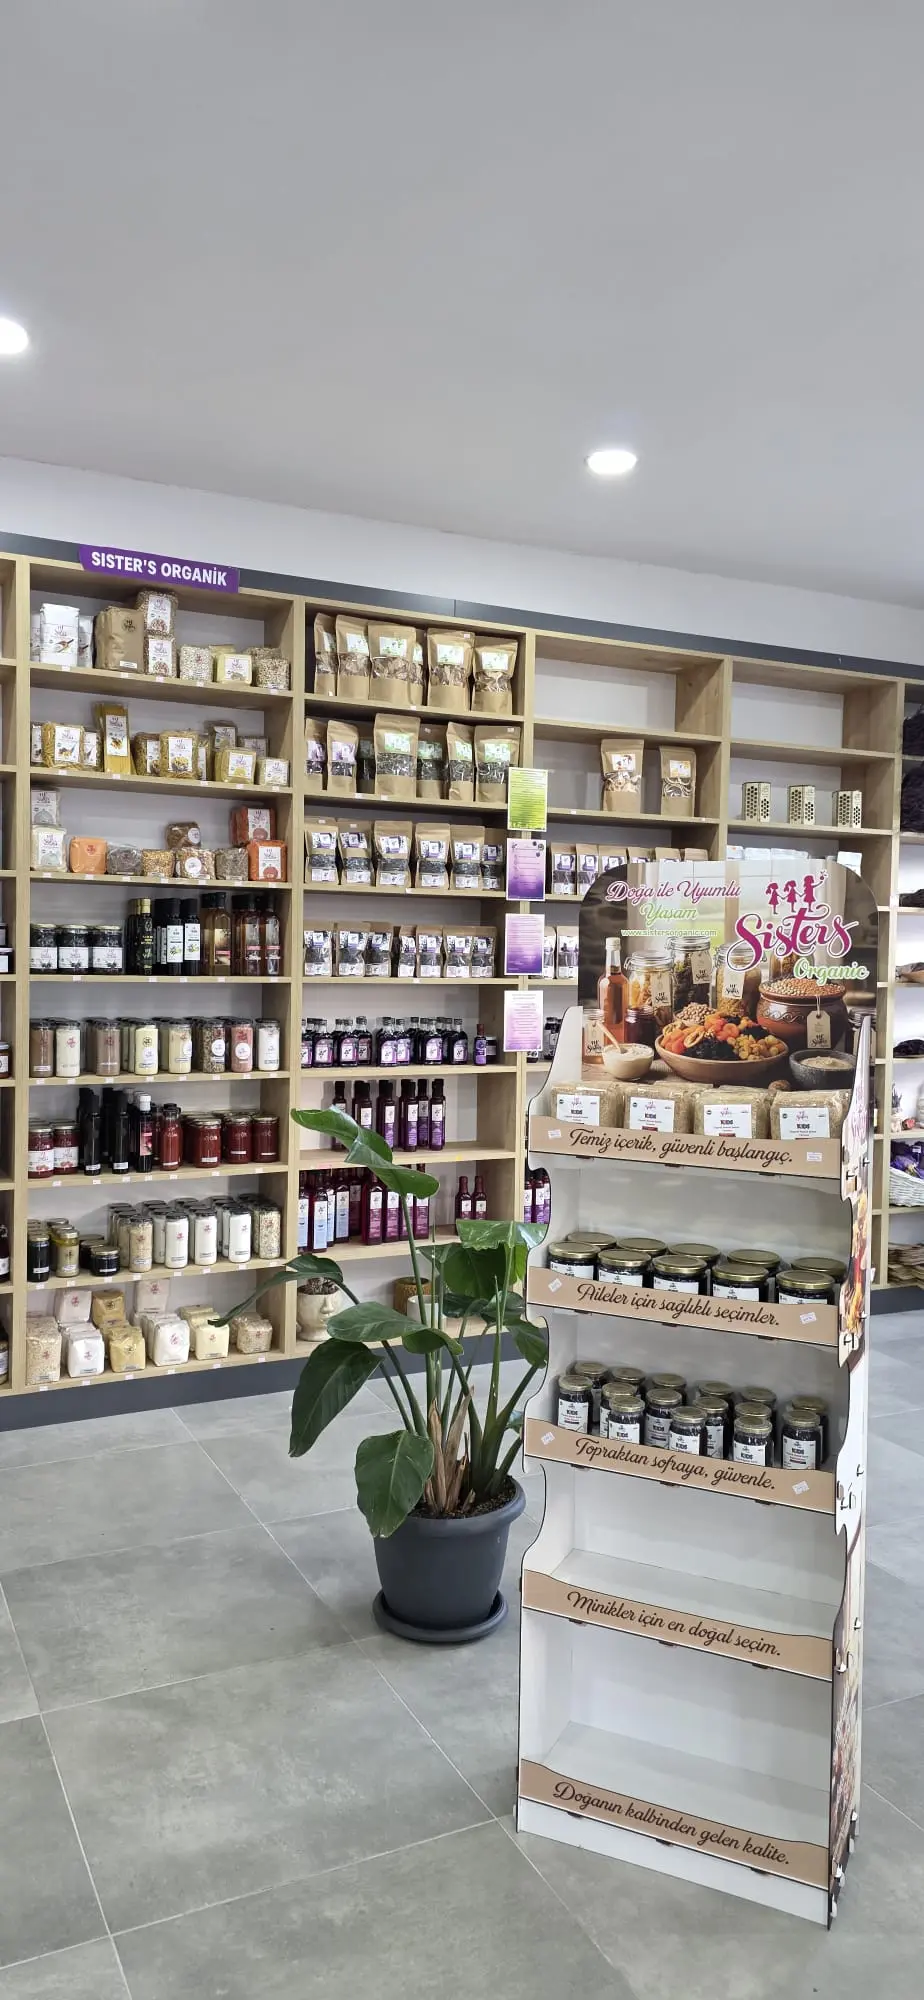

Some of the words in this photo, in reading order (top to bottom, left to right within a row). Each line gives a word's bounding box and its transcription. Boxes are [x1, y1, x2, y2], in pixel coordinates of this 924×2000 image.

[91, 552, 157, 575] SISTER'S
[161, 563, 227, 586] ORGANİK
[606, 880, 652, 905] Doğa
[657, 881, 675, 897] ile
[677, 880, 741, 904] Uyumlu
[727, 904, 859, 971] Sisters
[794, 958, 869, 985] Organic
[570, 1128, 612, 1153] Temiz
[614, 1134, 656, 1152] içerik,
[659, 1139, 715, 1158] güvenli
[717, 1141, 792, 1167] başlangıç.
[577, 1284, 628, 1304] Aileler
[631, 1293, 657, 1309] için
[659, 1297, 712, 1319] sağlıklı
[714, 1307, 779, 1325] seçimler.
[576, 1438, 648, 1465] Topraktan
[650, 1455, 708, 1480] sofraya,
[711, 1467, 775, 1489] güvenle.
[567, 1591, 636, 1620] Minikler
[638, 1610, 665, 1627] için
[668, 1620, 685, 1633] en
[688, 1621, 734, 1646] doğal
[733, 1635, 780, 1655] seçim.
[553, 1781, 622, 1810] Doğanın
[625, 1802, 697, 1836] kalbinden
[697, 1829, 740, 1849] gelen
[742, 1837, 789, 1864] kalite.
